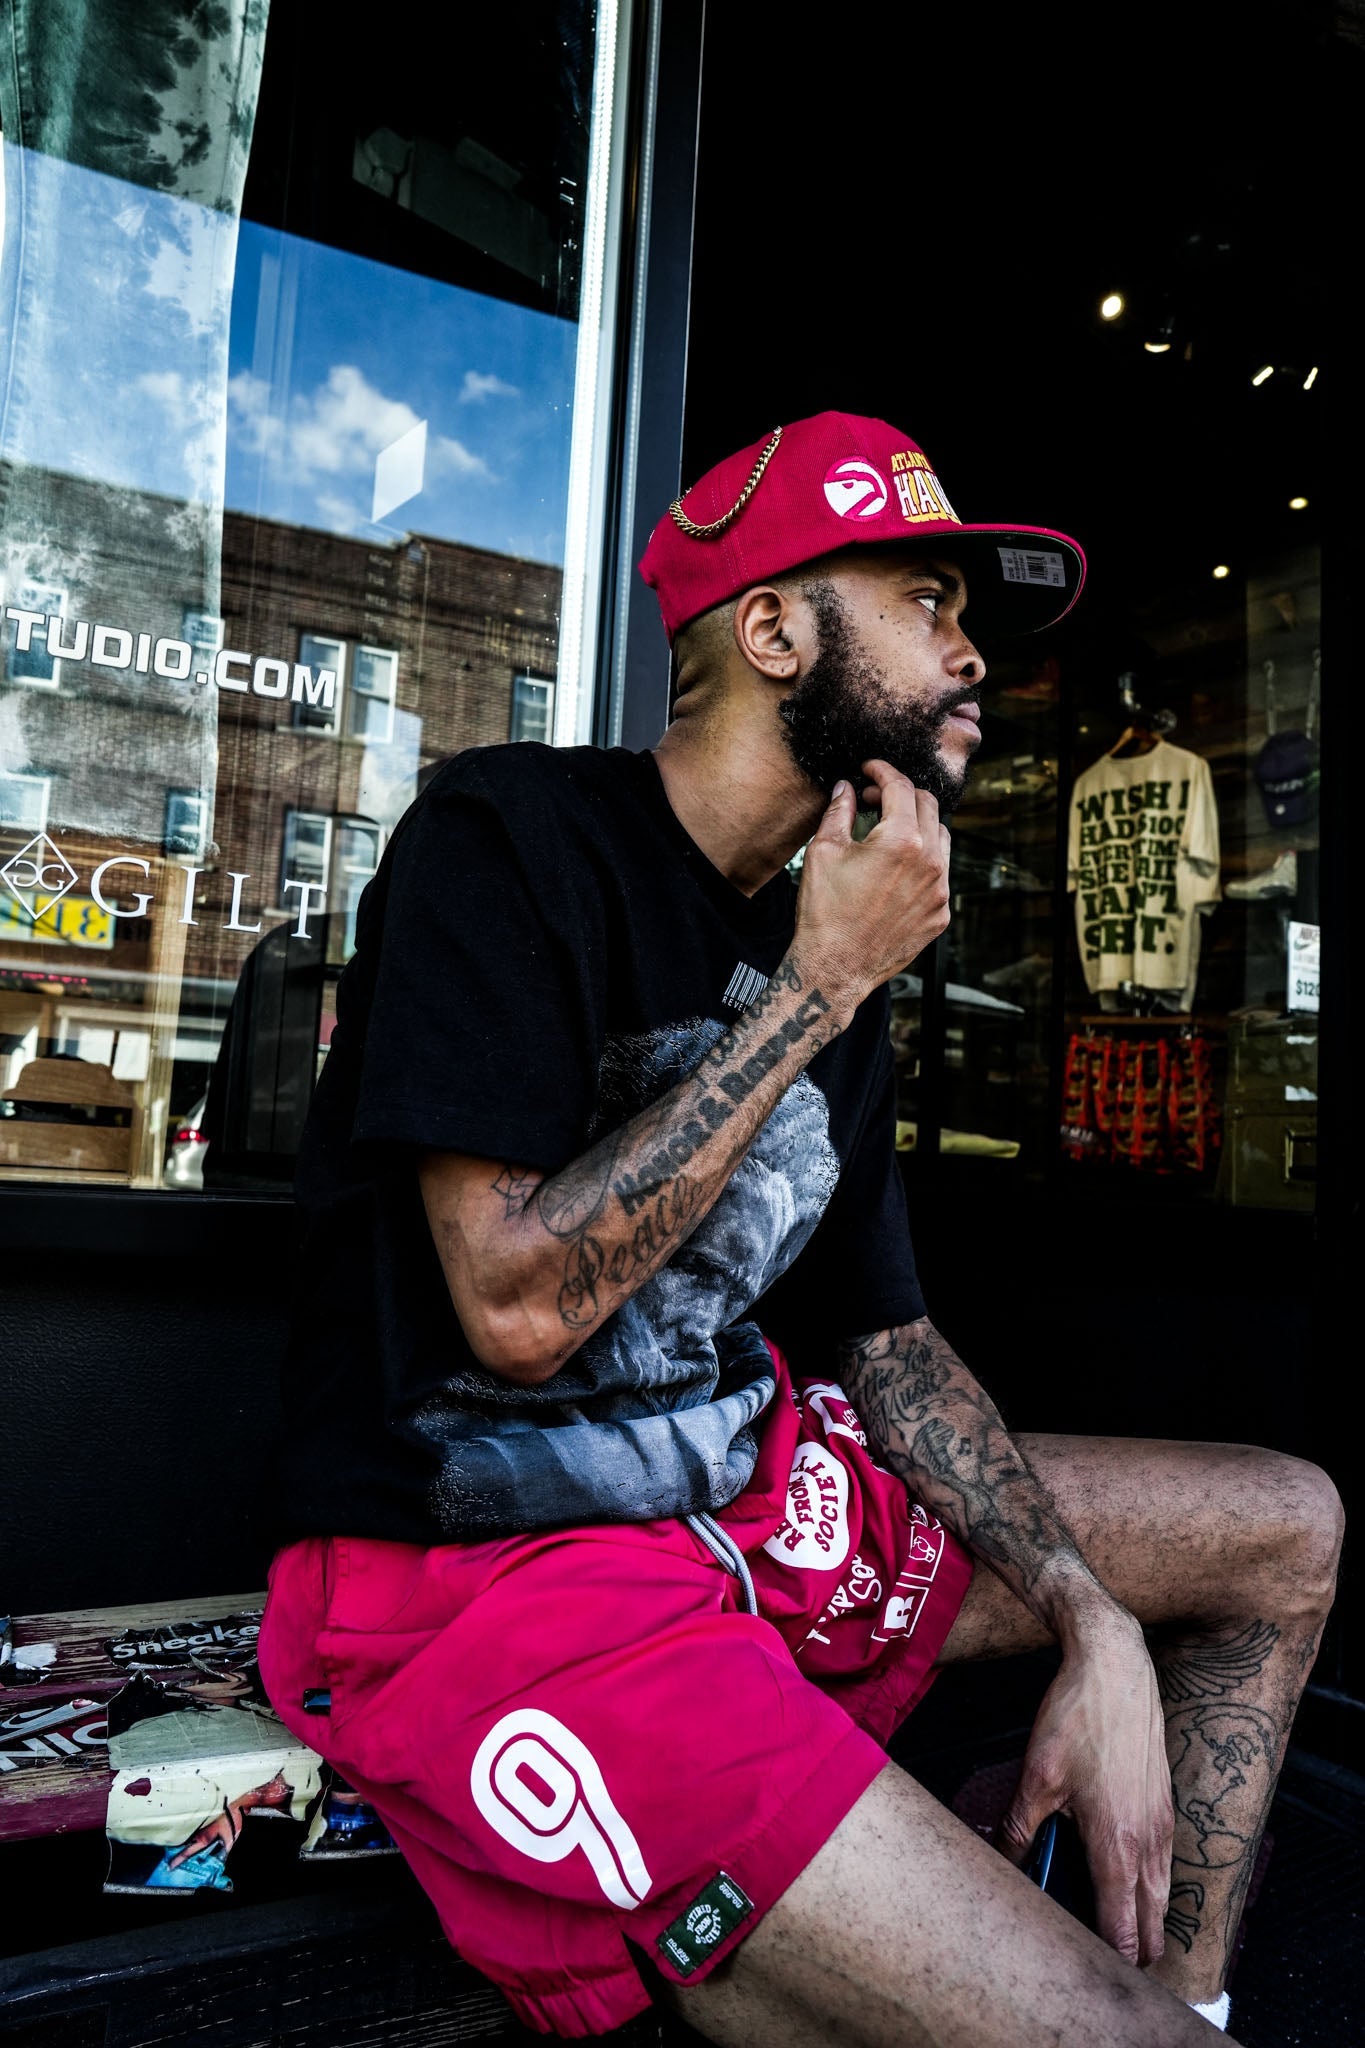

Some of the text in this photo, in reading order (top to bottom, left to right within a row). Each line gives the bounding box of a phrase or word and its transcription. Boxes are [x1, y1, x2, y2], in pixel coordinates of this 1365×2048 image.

[1076, 781, 1171, 822] WISH
[1080, 820, 1135, 846] HAD
[1079, 862, 1130, 890] SHE
[90, 856, 328, 940] GILT
[113, 1625, 261, 1659] Sneake
